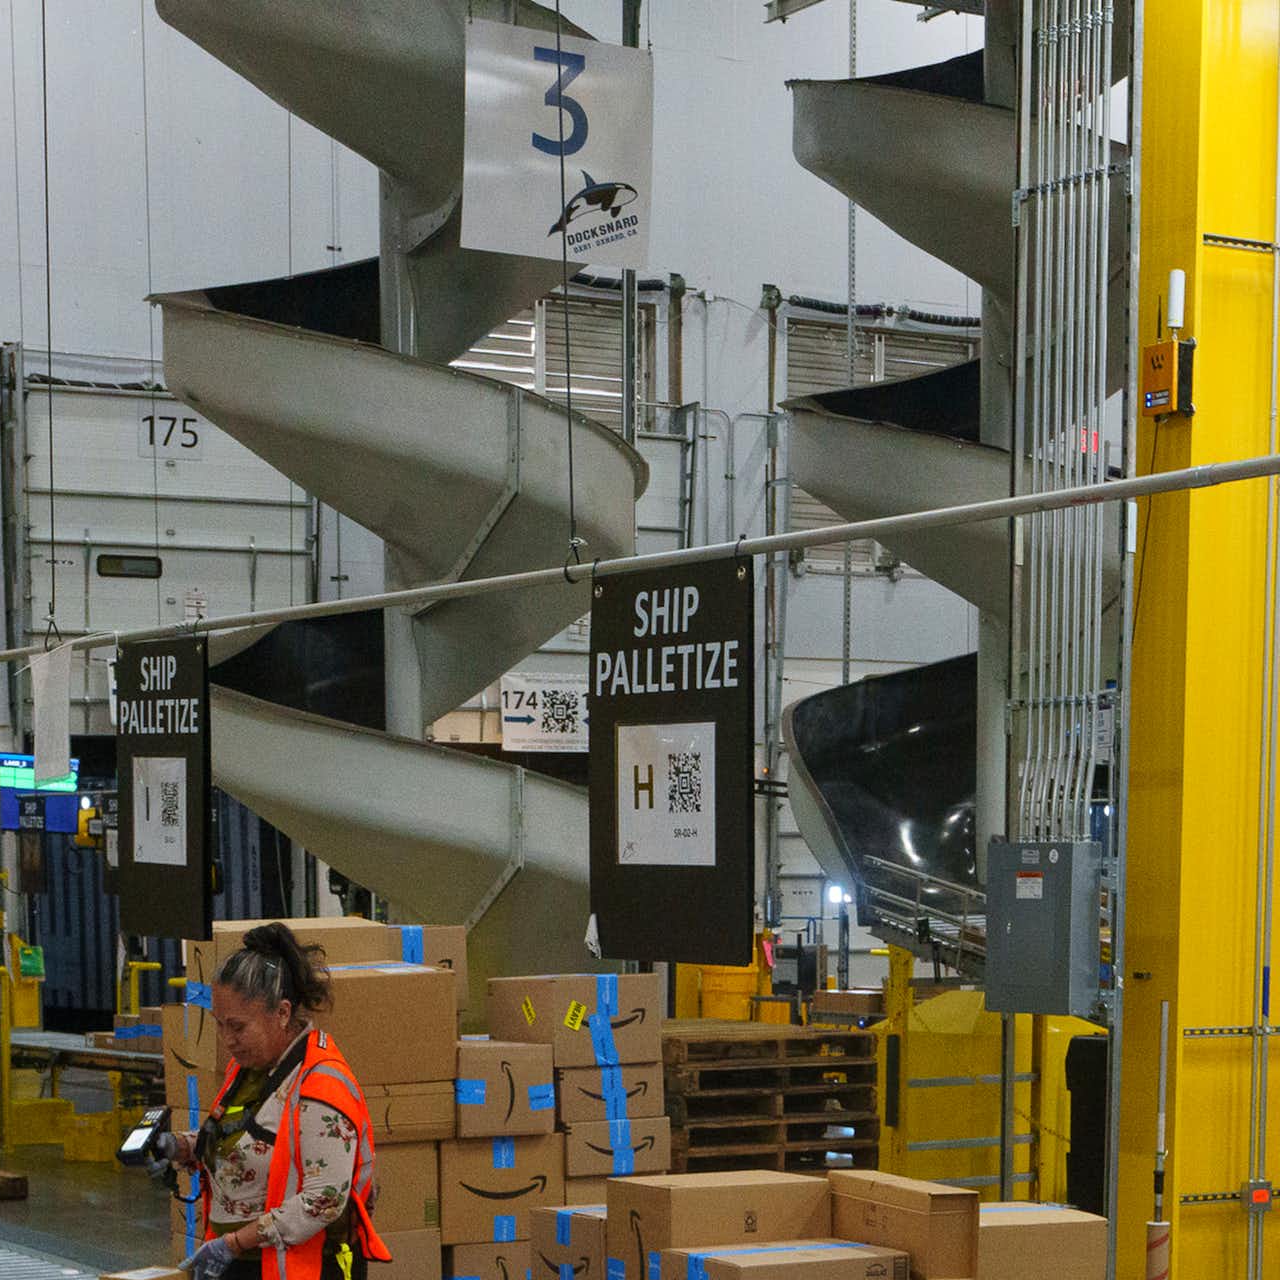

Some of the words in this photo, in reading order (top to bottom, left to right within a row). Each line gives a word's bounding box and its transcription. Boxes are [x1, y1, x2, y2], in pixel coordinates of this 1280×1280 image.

[532, 46, 588, 156] 3
[567, 215, 639, 246] DOCKSNARD
[141, 415, 199, 448] 175
[634, 586, 700, 637] SHIP
[140, 656, 176, 691] SHIP
[596, 640, 739, 697] PALLETIZE
[120, 698, 199, 735] PALLETIZE
[502, 690, 538, 709] 174
[634, 764, 654, 809] H
[568, 1003, 583, 1028] HEAVY
